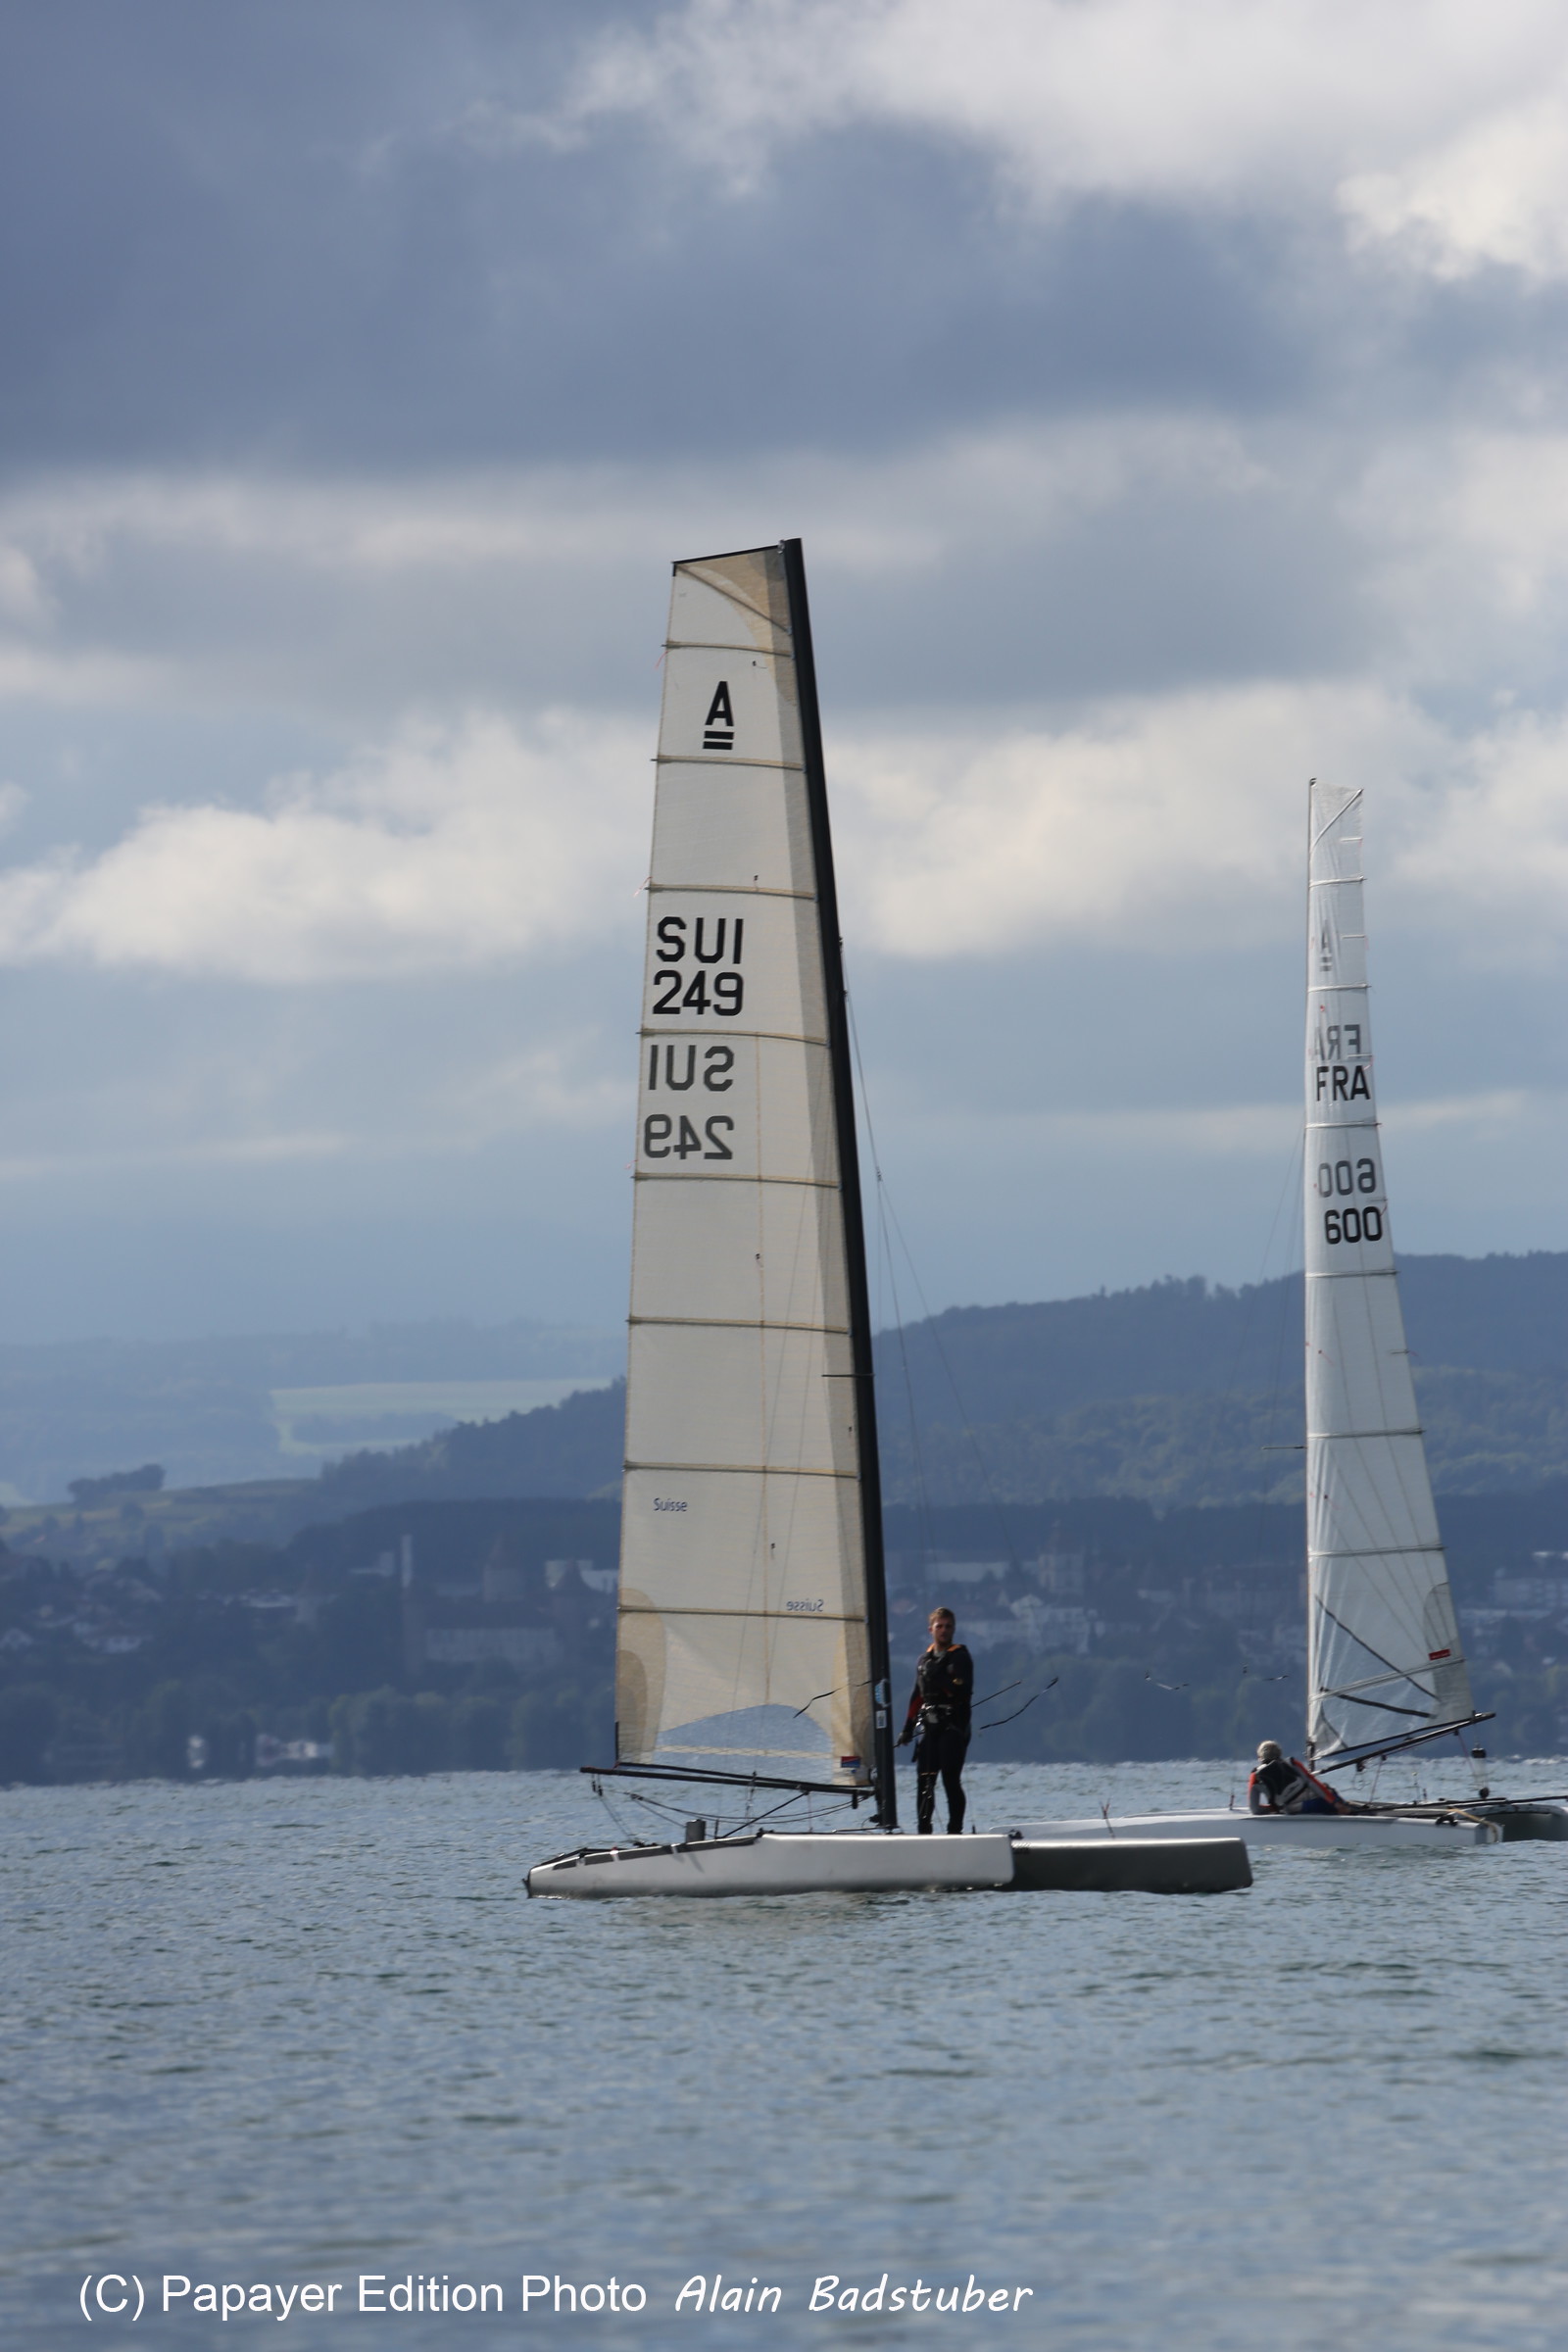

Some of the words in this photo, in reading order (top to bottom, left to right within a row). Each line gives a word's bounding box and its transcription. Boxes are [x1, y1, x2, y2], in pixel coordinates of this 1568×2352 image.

[705, 680, 735, 728] A
[656, 915, 745, 965] SUI
[652, 969, 745, 1017] 249
[1316, 1064, 1371, 1102] FRA
[1323, 1206, 1384, 1246] 600
[653, 1497, 688, 1512] Suisse
